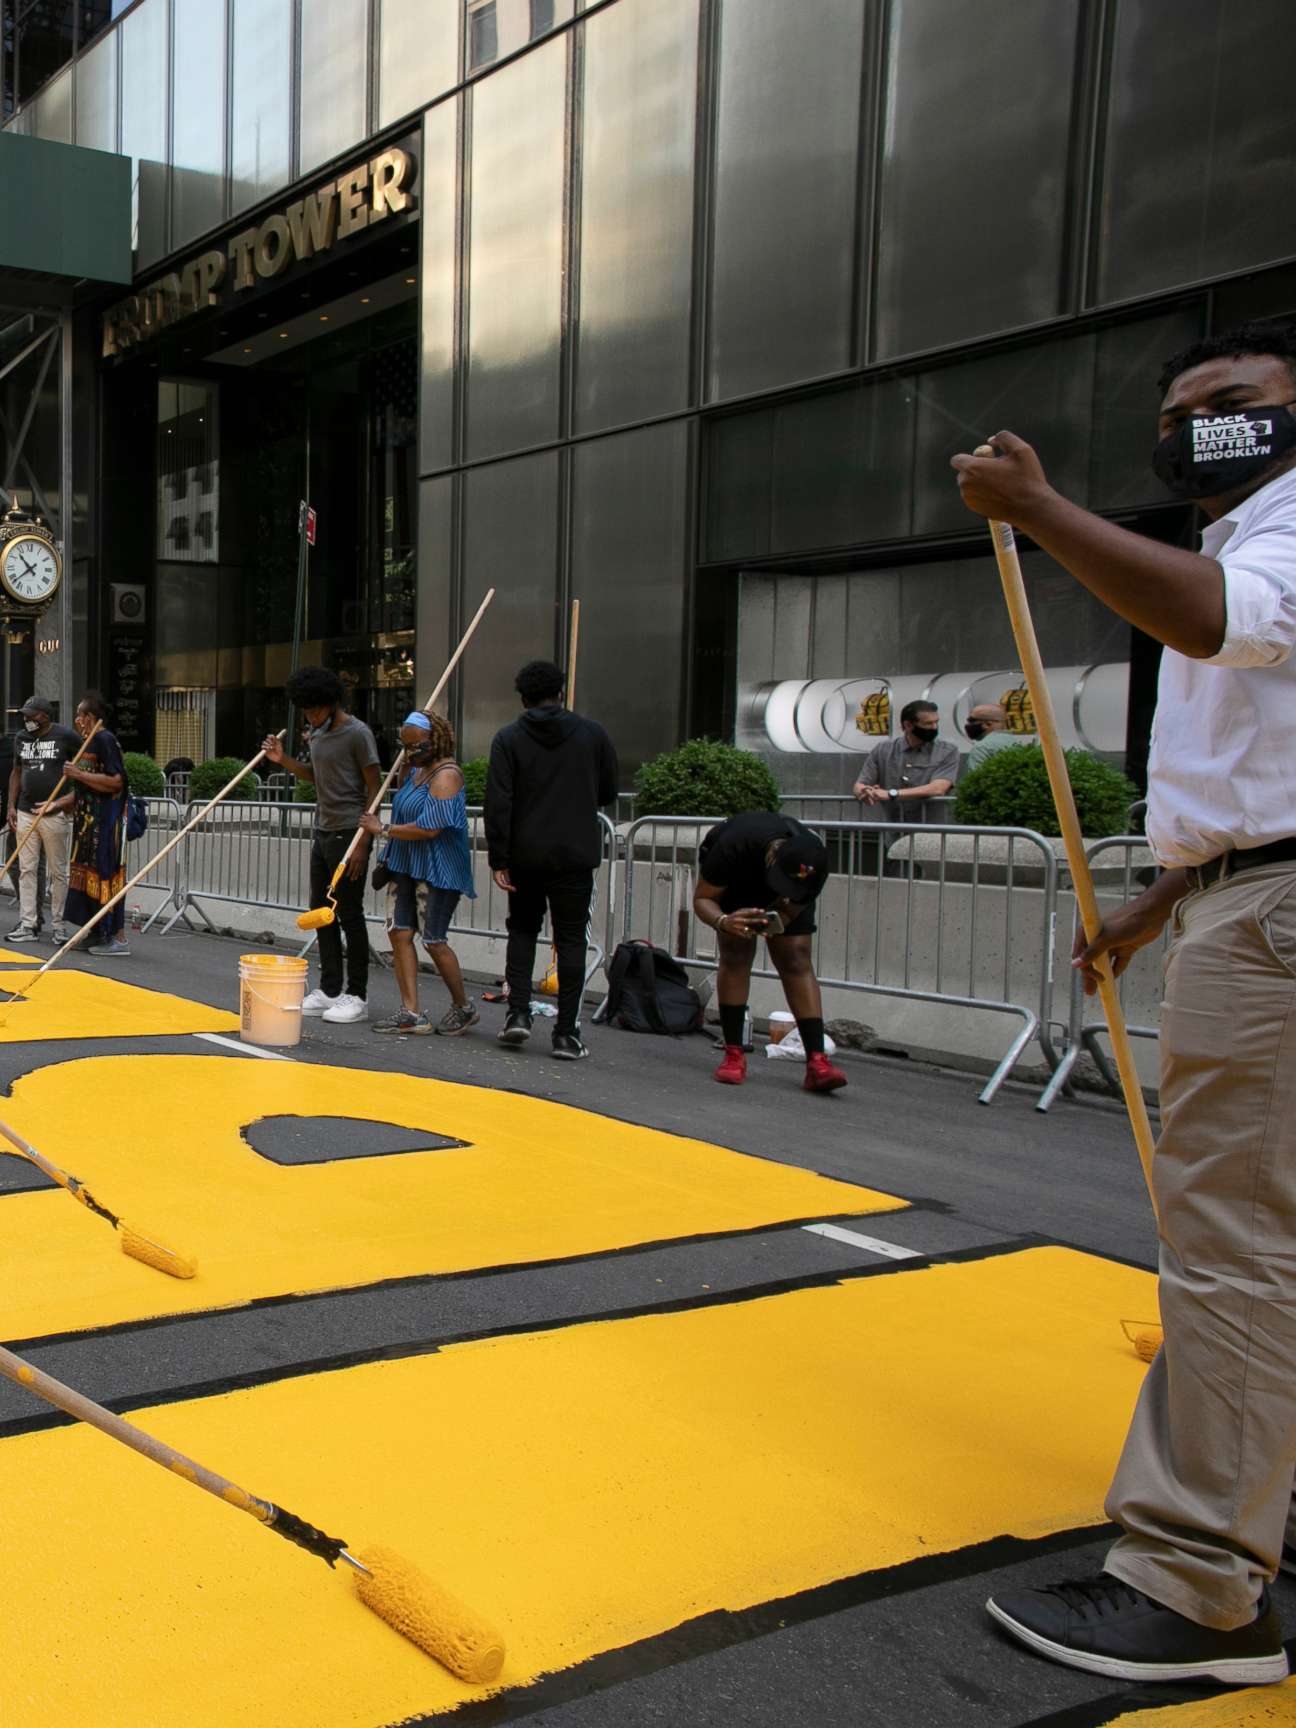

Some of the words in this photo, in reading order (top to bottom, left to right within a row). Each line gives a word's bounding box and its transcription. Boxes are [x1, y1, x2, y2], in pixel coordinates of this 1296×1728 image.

[229, 147, 412, 292] TOWER
[1193, 414, 1247, 427] BLACK
[1197, 426, 1246, 441] LIVES
[1194, 437, 1256, 452] MATTER
[1193, 445, 1271, 462] BROOKLYN
